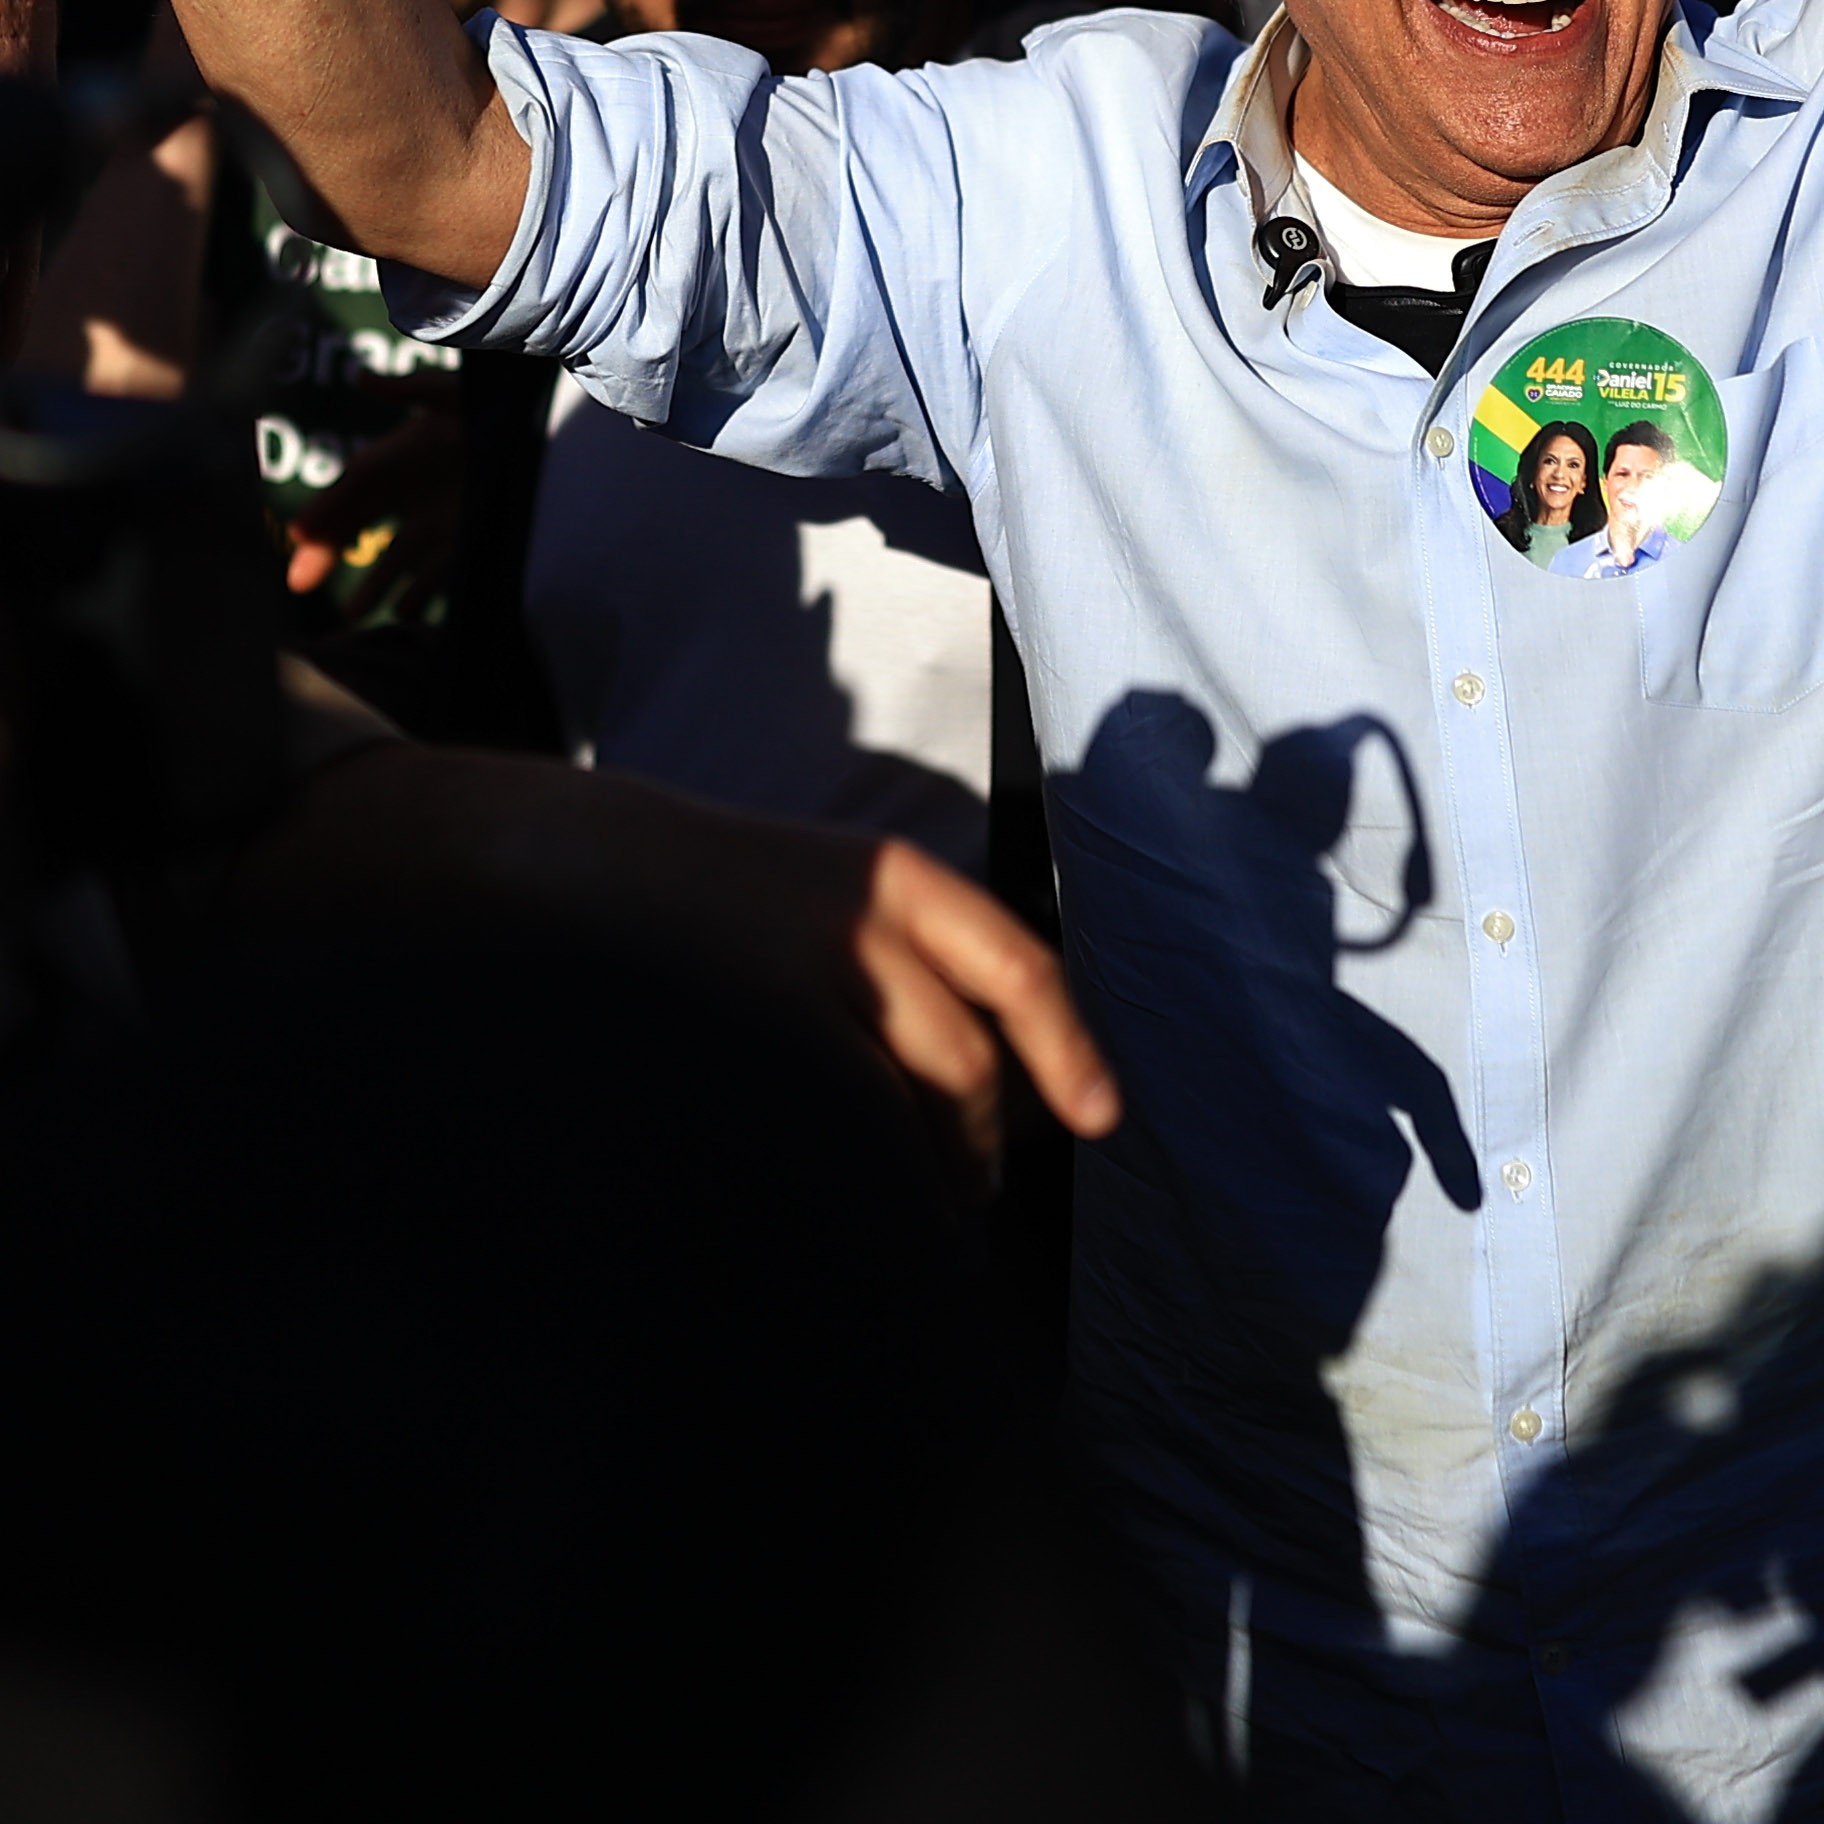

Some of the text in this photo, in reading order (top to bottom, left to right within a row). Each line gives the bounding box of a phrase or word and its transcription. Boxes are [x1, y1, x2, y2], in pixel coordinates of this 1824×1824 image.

[1526, 356, 1585, 385] 444
[1609, 361, 1674, 372] GOVERNADOR
[1597, 369, 1652, 390] Daniel
[1545, 389, 1583, 399] CAIADO
[1599, 387, 1650, 401] VILELA
[1654, 372, 1687, 403] 15
[1642, 402, 1668, 411] CARMO
